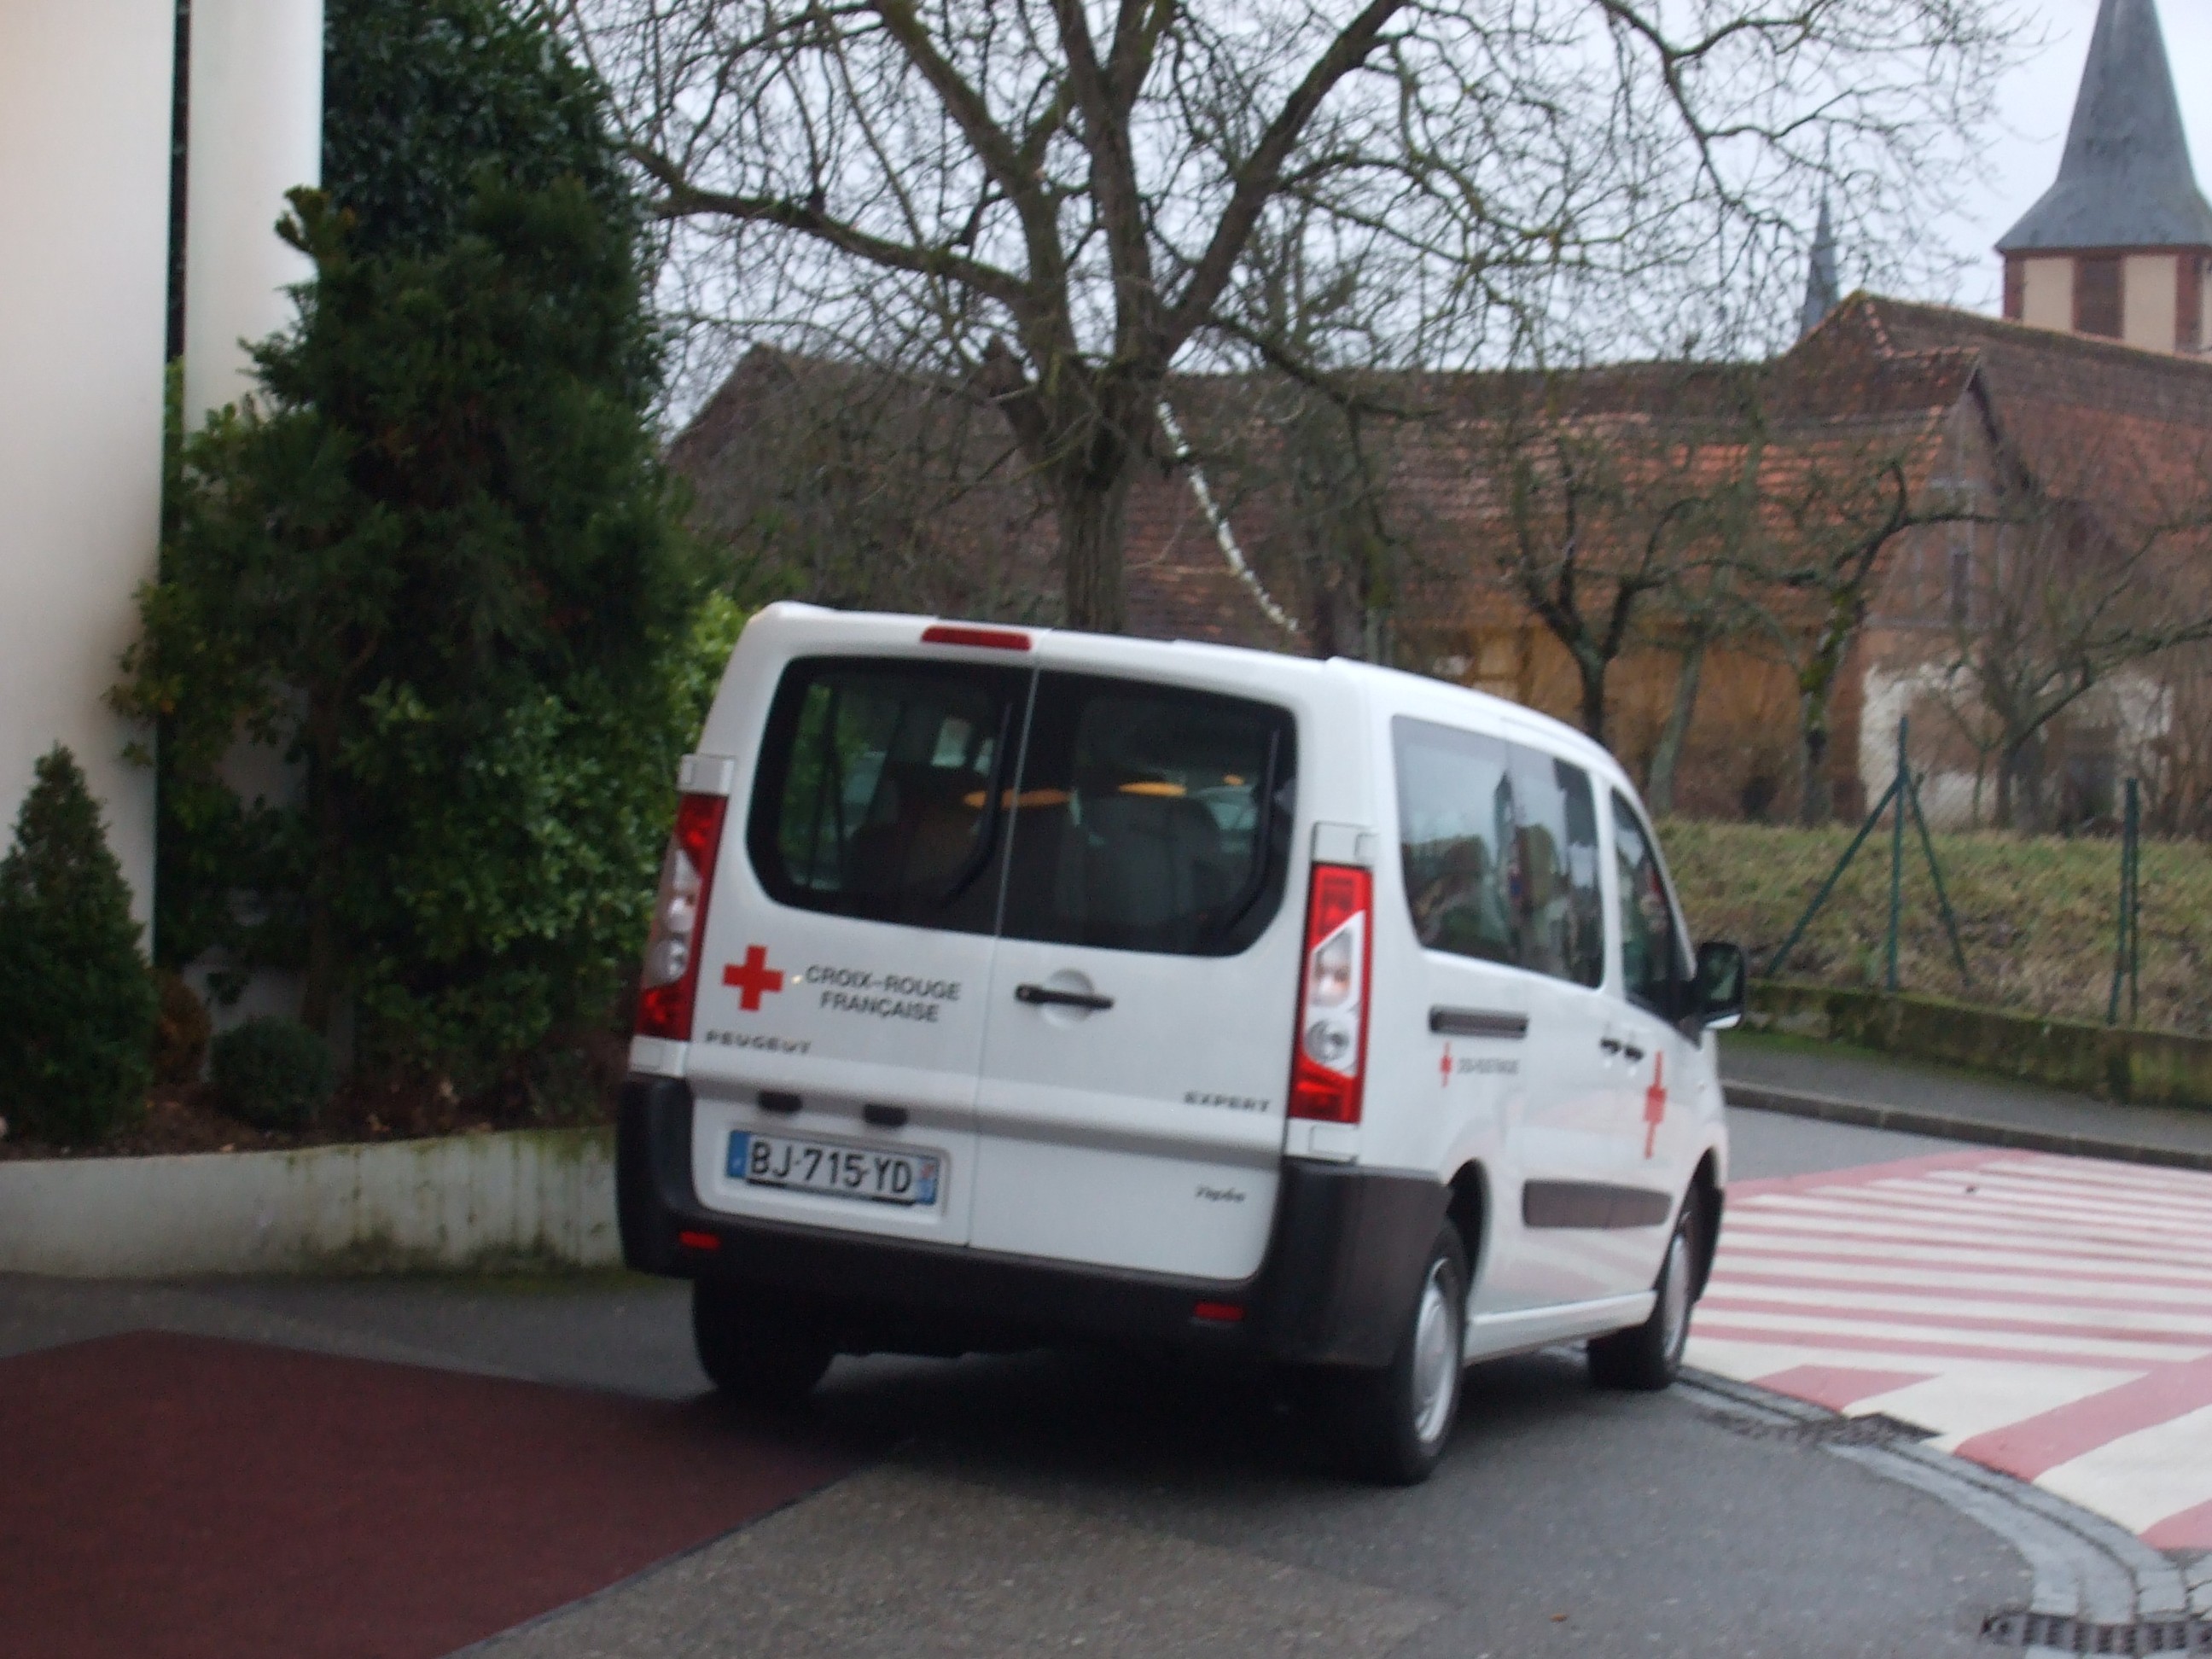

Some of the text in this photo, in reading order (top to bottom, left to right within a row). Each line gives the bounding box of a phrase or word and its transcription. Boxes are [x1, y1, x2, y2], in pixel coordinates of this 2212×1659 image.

[806, 964, 961, 1000] CROIX-ROUGE
[706, 1030, 811, 1053] PEUGEOT
[1185, 1091, 1269, 1113] EXPERT
[750, 1141, 911, 1193] BJ-715-YD
